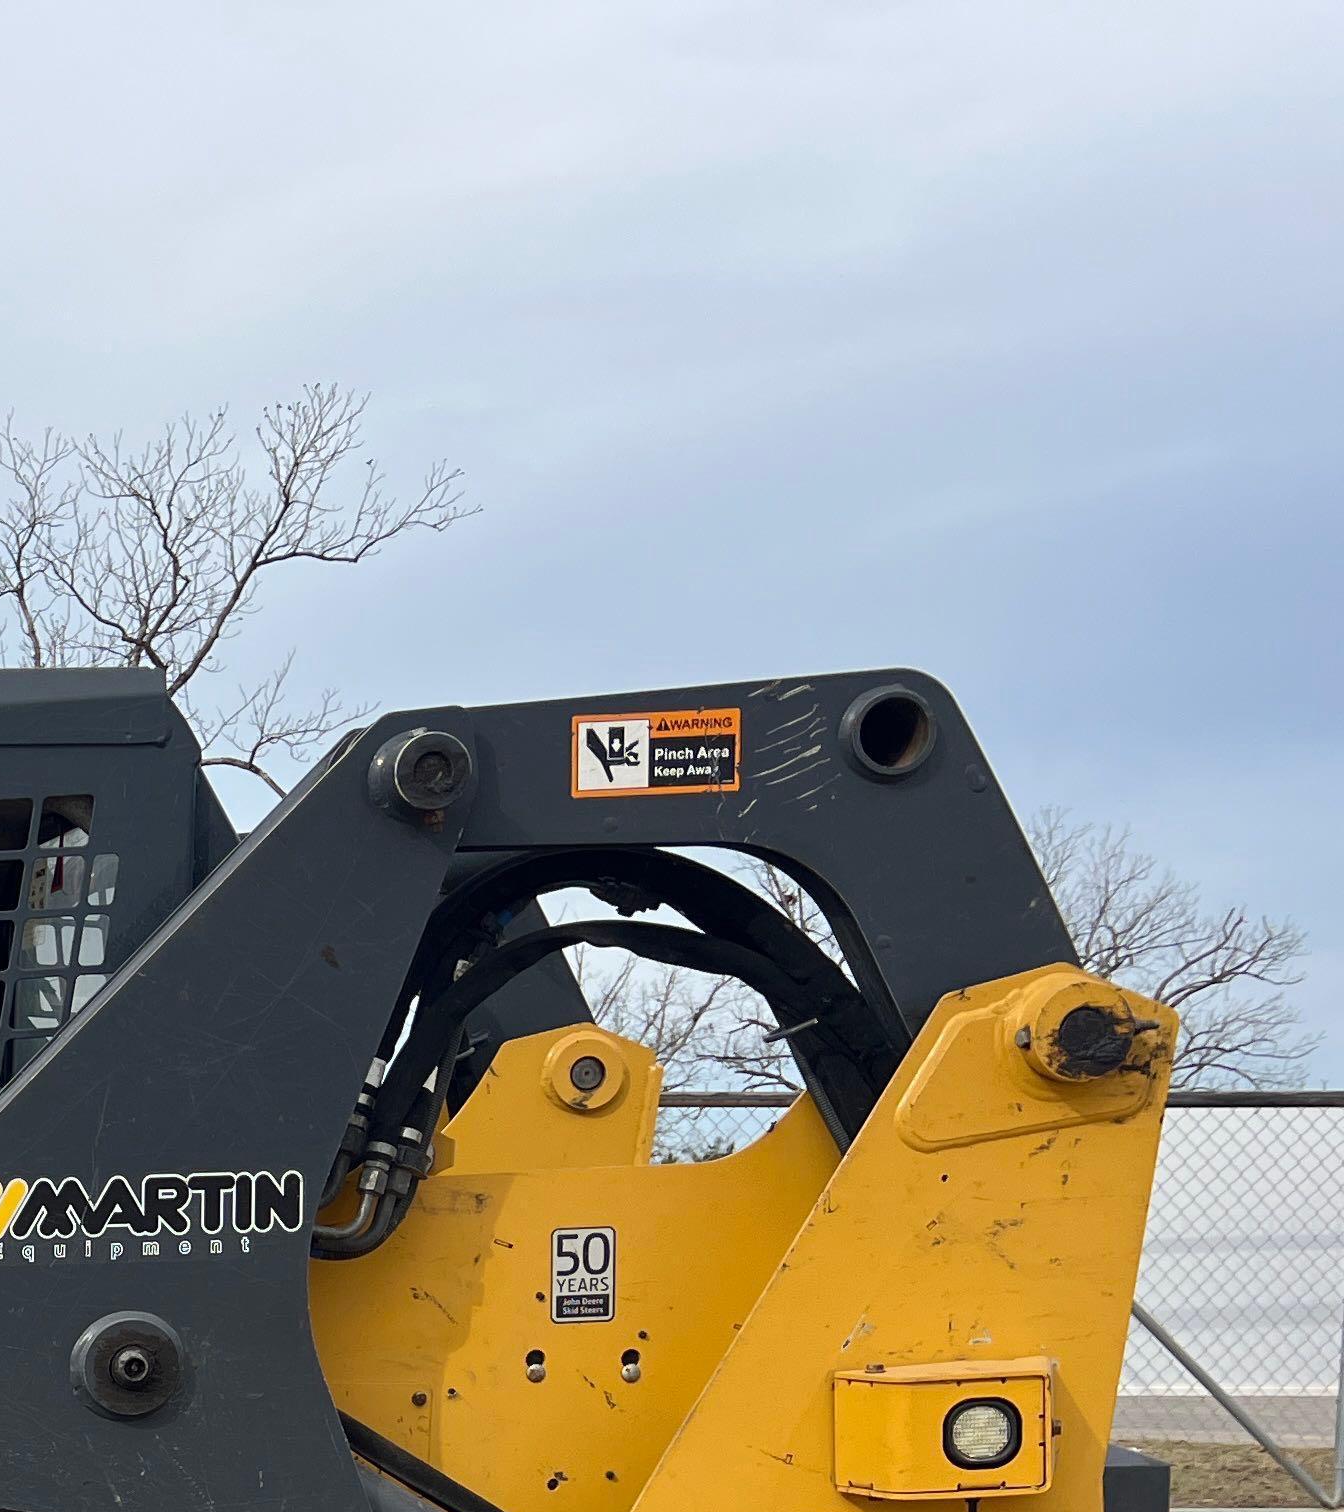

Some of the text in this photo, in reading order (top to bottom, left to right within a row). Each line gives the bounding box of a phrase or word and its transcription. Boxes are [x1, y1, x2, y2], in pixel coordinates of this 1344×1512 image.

[670, 717, 733, 731] WARNING
[654, 746, 730, 760] Pinch Area
[654, 765, 685, 778] Keep
[11, 1169, 304, 1239] MARTIN
[556, 1232, 611, 1277] 50
[556, 1276, 610, 1293] YEARS
